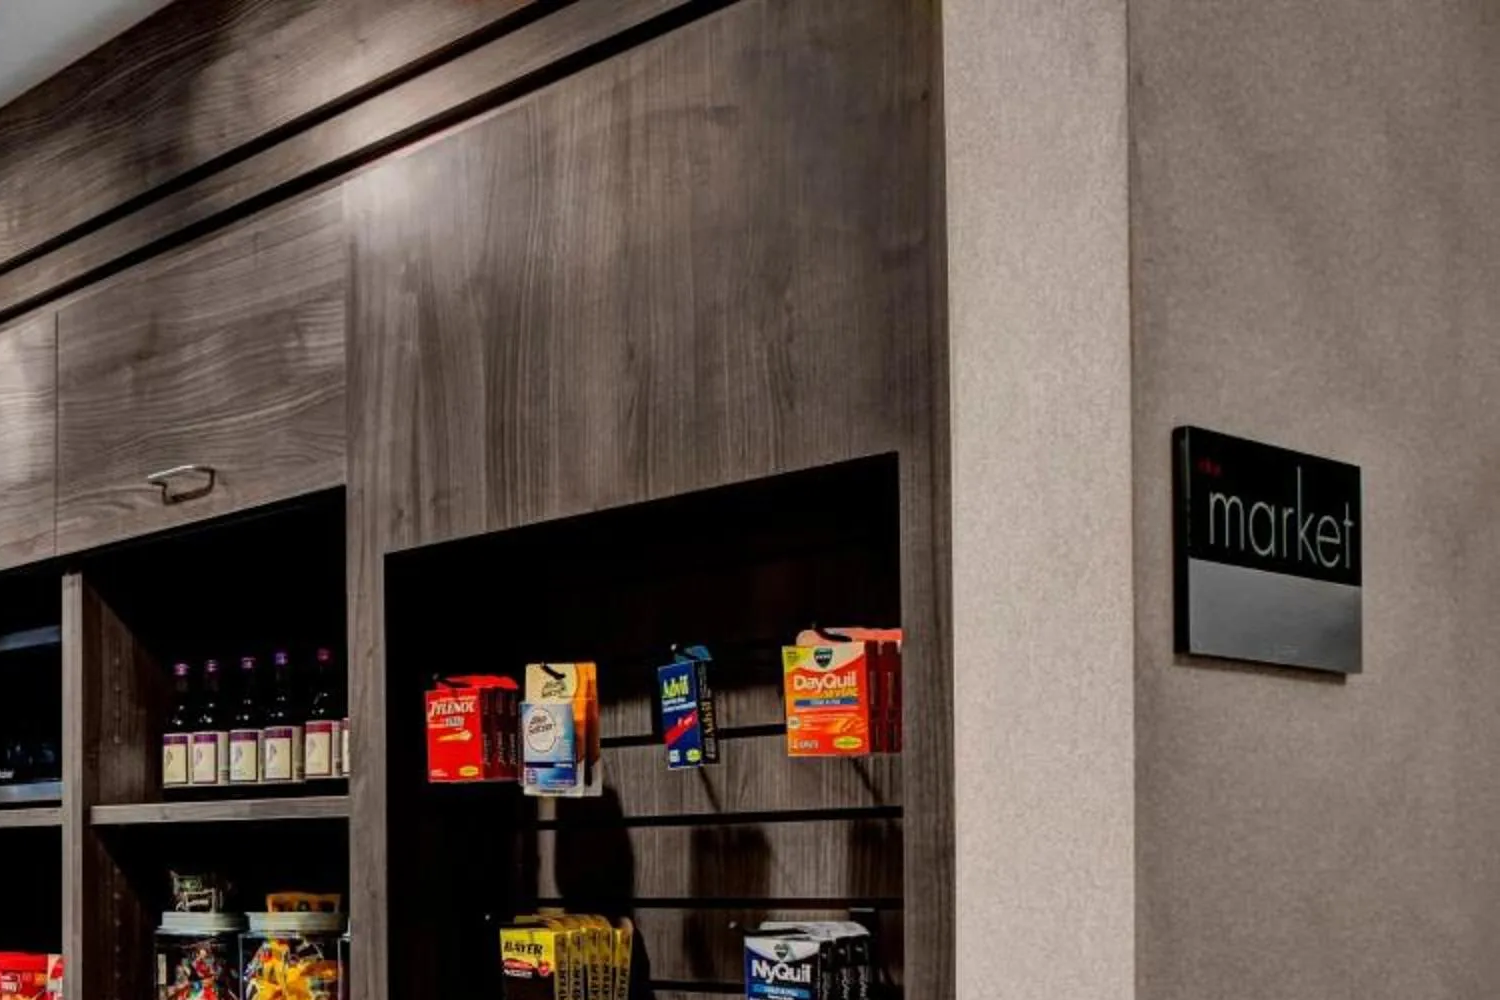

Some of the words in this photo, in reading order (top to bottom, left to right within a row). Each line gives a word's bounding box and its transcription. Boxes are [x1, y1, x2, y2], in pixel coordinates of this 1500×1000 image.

[1208, 466, 1354, 569] market
[663, 674, 689, 697] Advil
[793, 671, 857, 694] DayQuil
[428, 700, 476, 718] TYLENOL
[503, 941, 543, 956] BAYER
[751, 959, 812, 984] NyQuil
